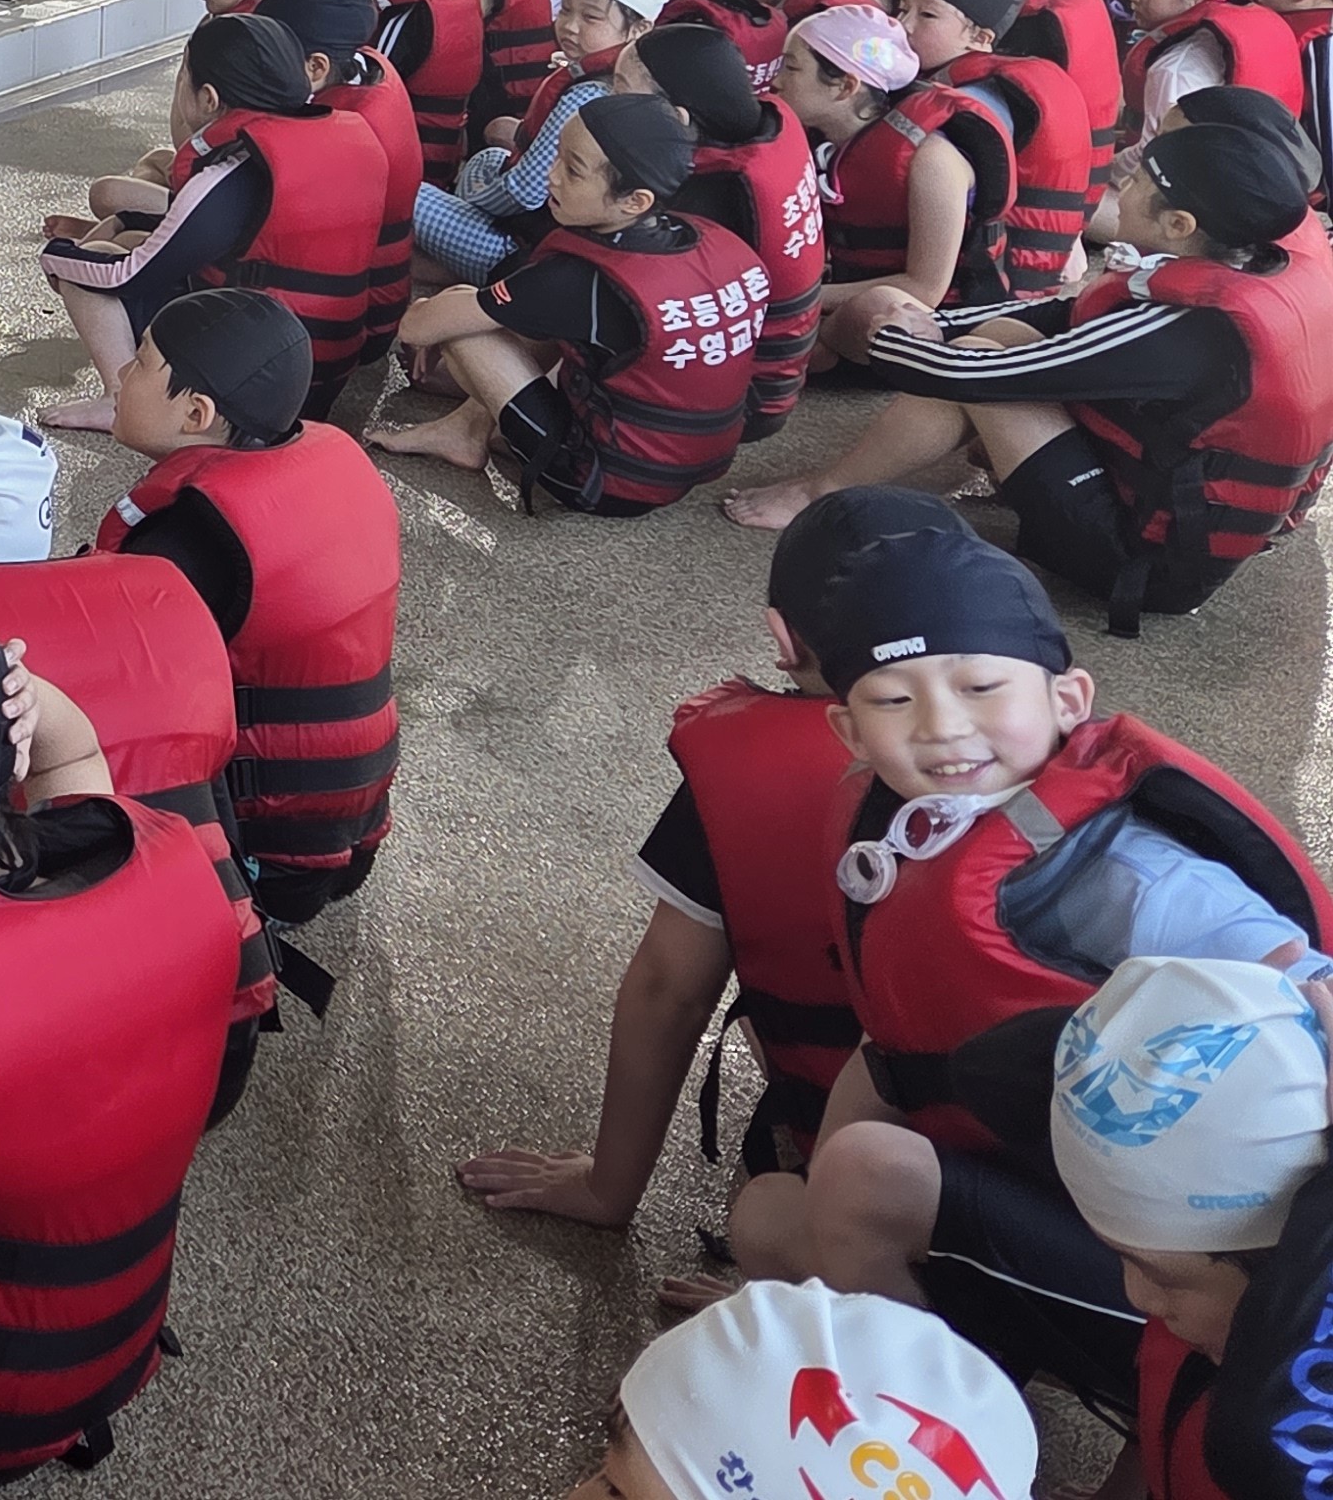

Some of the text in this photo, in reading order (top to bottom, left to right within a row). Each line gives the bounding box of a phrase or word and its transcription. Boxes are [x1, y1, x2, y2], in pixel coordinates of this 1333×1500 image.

[657, 266, 770, 332] 초등생존
[871, 636, 926, 662] arena
[1187, 1192, 1270, 1211] arena
